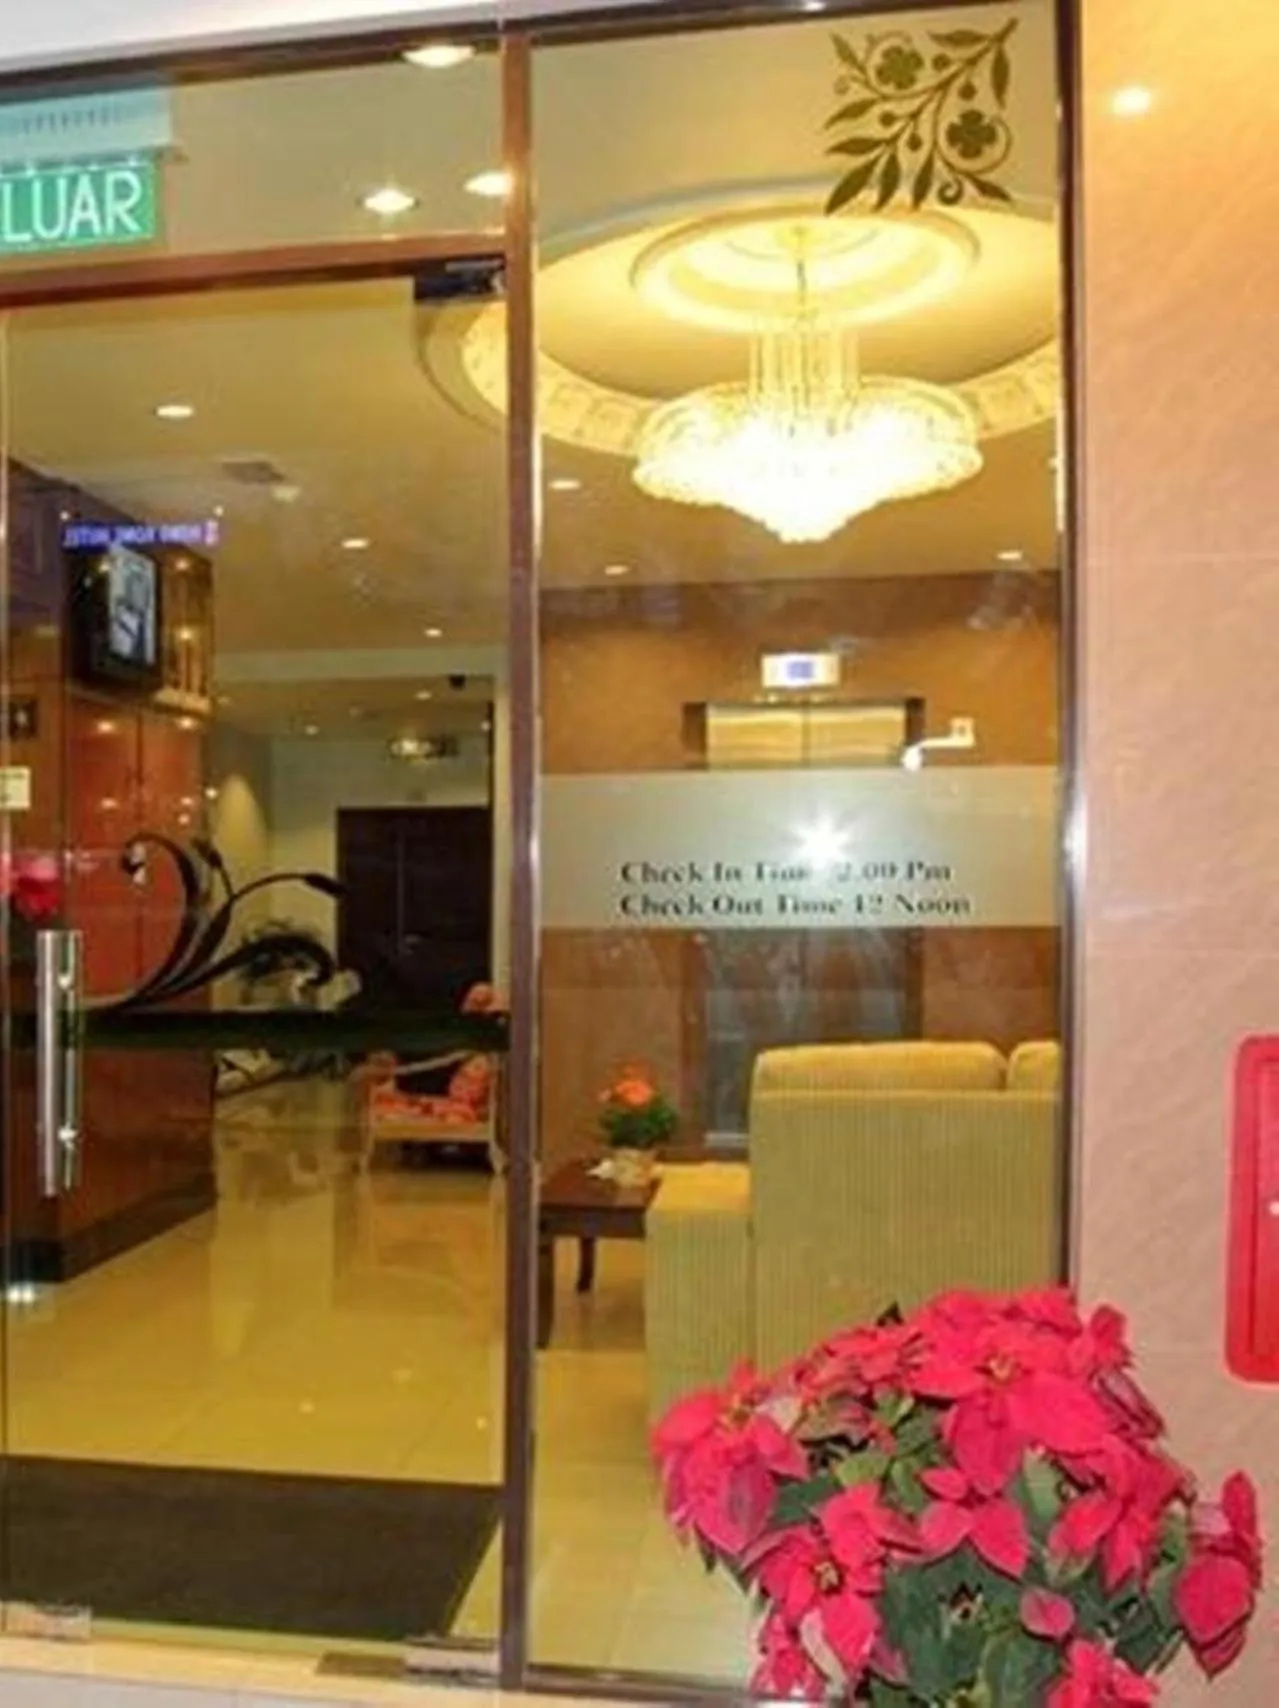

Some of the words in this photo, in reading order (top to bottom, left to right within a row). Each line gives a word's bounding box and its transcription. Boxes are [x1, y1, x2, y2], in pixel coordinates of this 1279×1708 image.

[621, 861, 703, 883] Check
[621, 894, 704, 915] Check
[712, 895, 764, 915] Out
[894, 893, 971, 914] Noon
